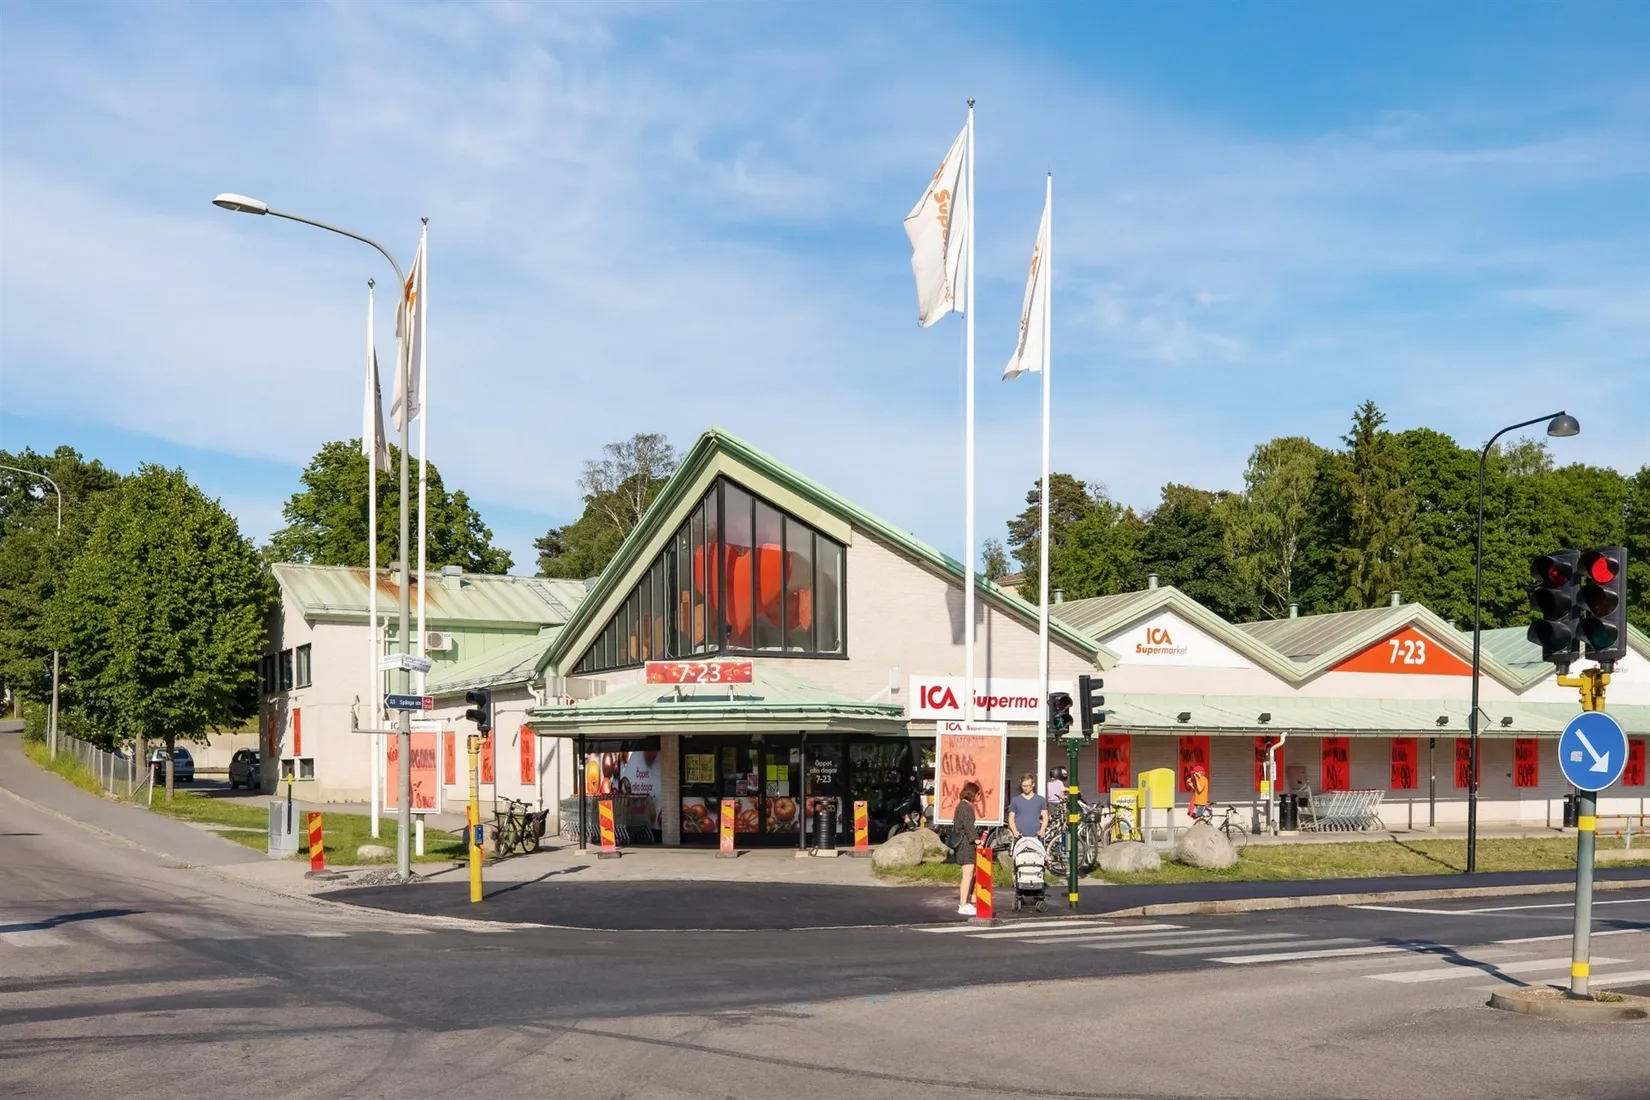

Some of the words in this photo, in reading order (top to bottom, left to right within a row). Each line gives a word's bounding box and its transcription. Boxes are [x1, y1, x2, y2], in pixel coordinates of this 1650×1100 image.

[1146, 628, 1173, 645] ICA
[1135, 643, 1188, 656] Supermarket
[1389, 639, 1426, 665] 7-23
[678, 664, 721, 683] 7-23
[920, 685, 960, 710] ICA
[973, 689, 1038, 711] uperma
[945, 722, 962, 731] ICA
[966, 724, 1000, 732] Supermarket
[815, 759, 832, 767] Öppet
[636, 767, 649, 779] Öppet
[820, 767, 837, 775] dagar
[816, 775, 831, 783] 7-23
